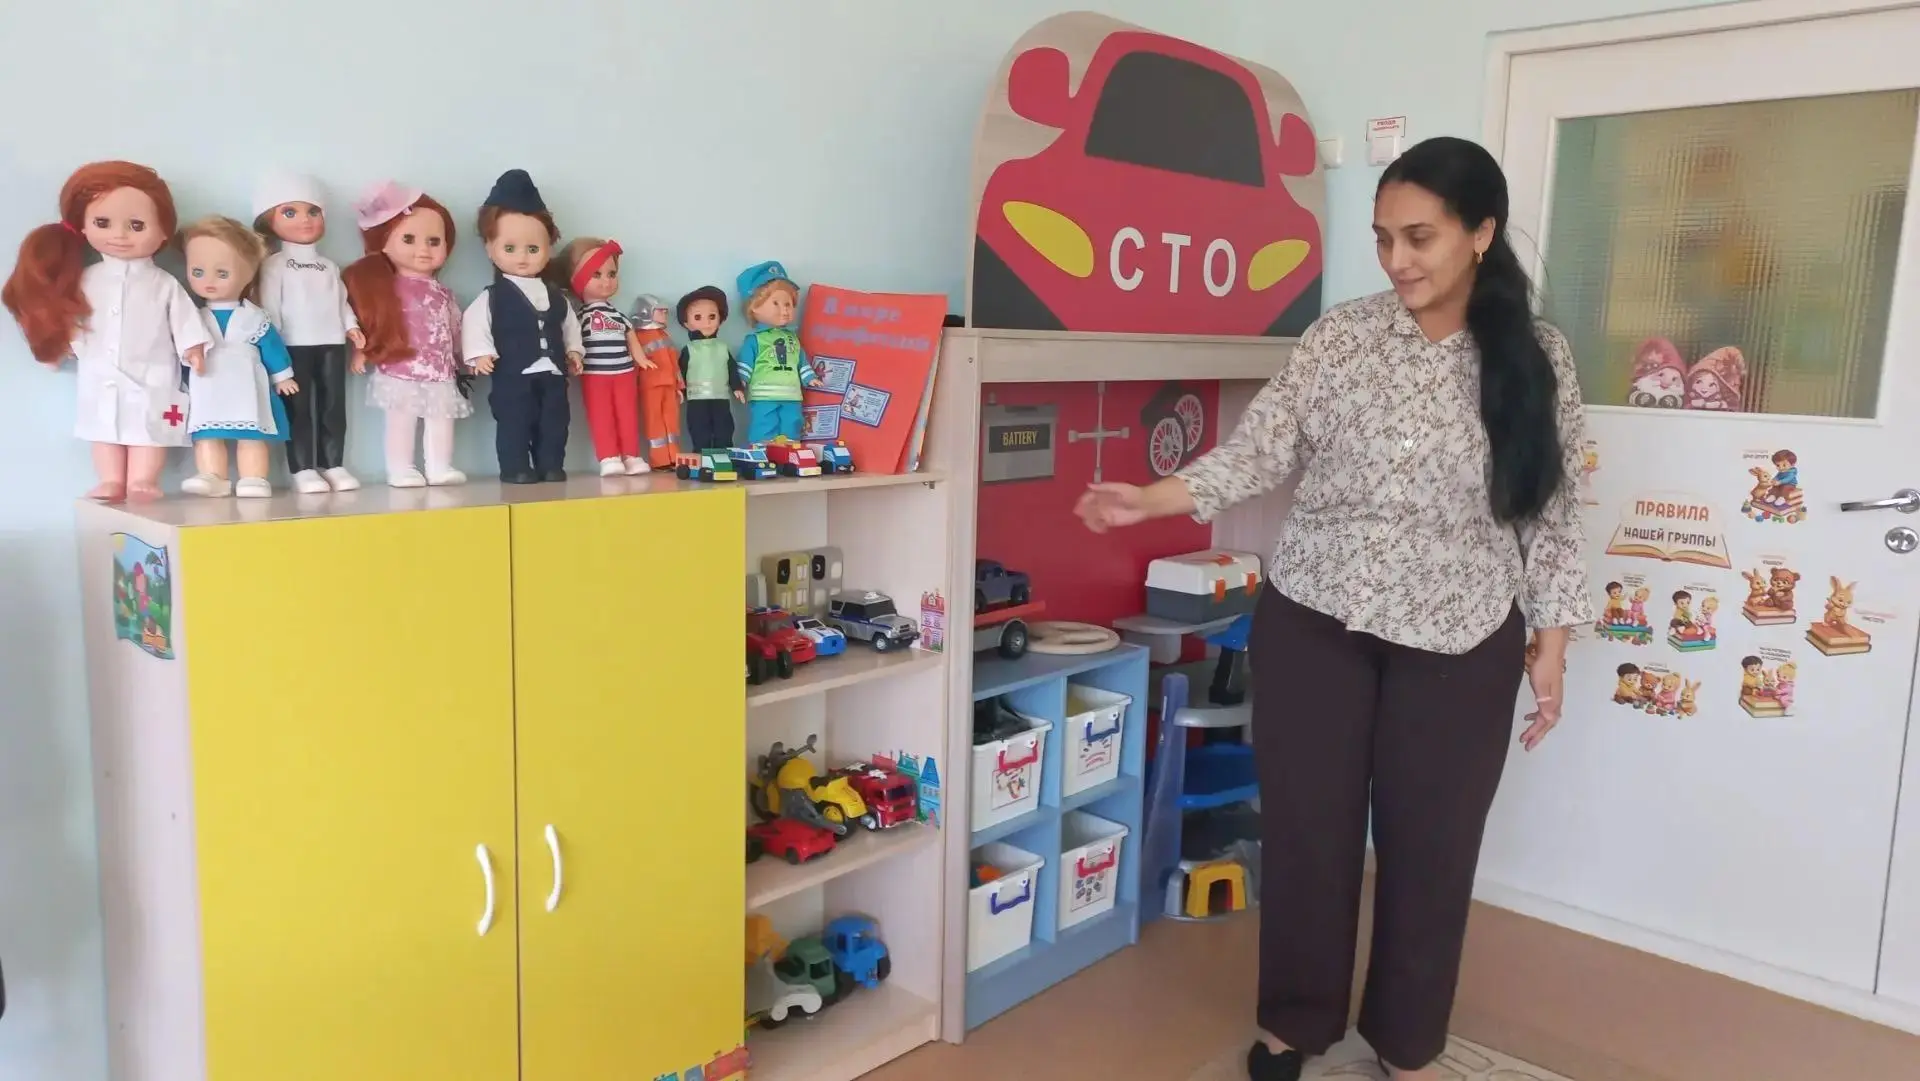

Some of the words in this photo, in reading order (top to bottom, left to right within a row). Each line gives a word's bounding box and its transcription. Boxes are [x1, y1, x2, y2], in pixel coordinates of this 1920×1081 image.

[1110, 226, 1237, 297] СТО
[1002, 431, 1038, 446] BATTERY
[1635, 500, 1710, 522] ПРАВИЛА
[1623, 526, 1664, 542] НАШЕЙ
[1667, 531, 1716, 547] ГРУППЫ
